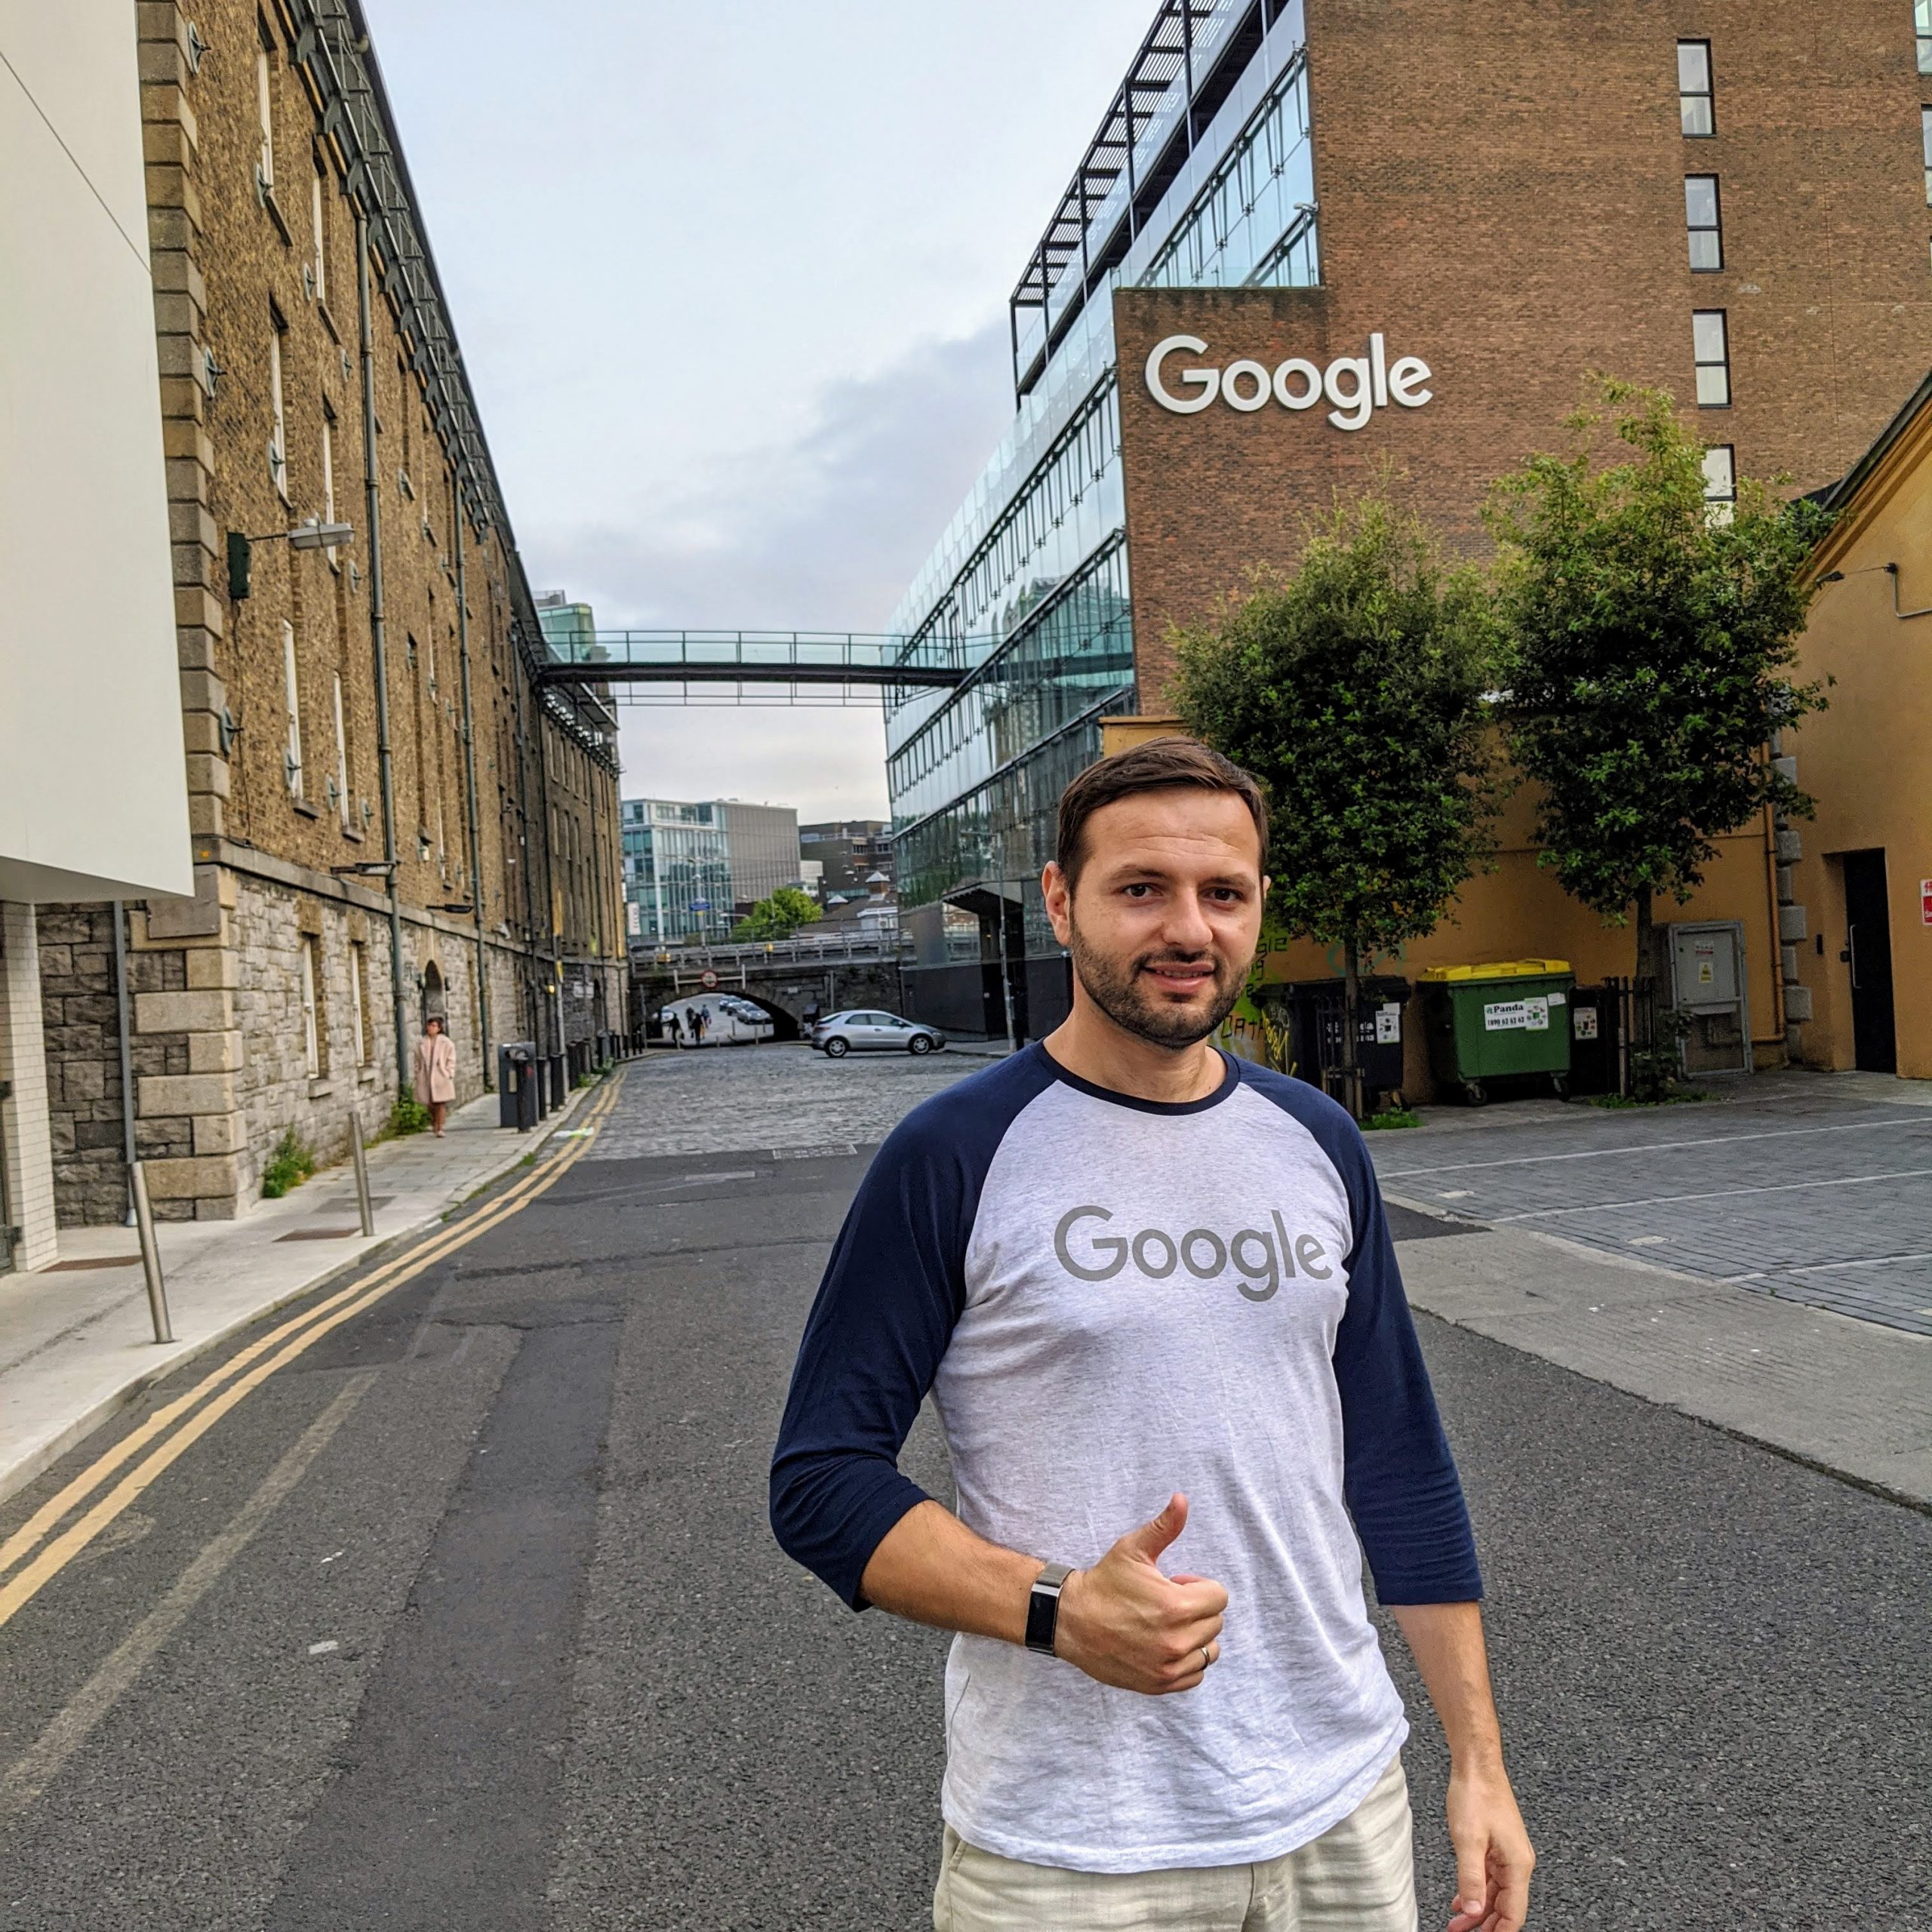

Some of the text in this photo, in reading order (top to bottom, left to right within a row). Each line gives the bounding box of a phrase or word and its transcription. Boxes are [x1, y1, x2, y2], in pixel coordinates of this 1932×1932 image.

[1145, 332, 1433, 431] Google
[1487, 1018, 1500, 1026] 1890
[1494, 1004, 1524, 1013] Panda
[1054, 1204, 1333, 1302] Google
